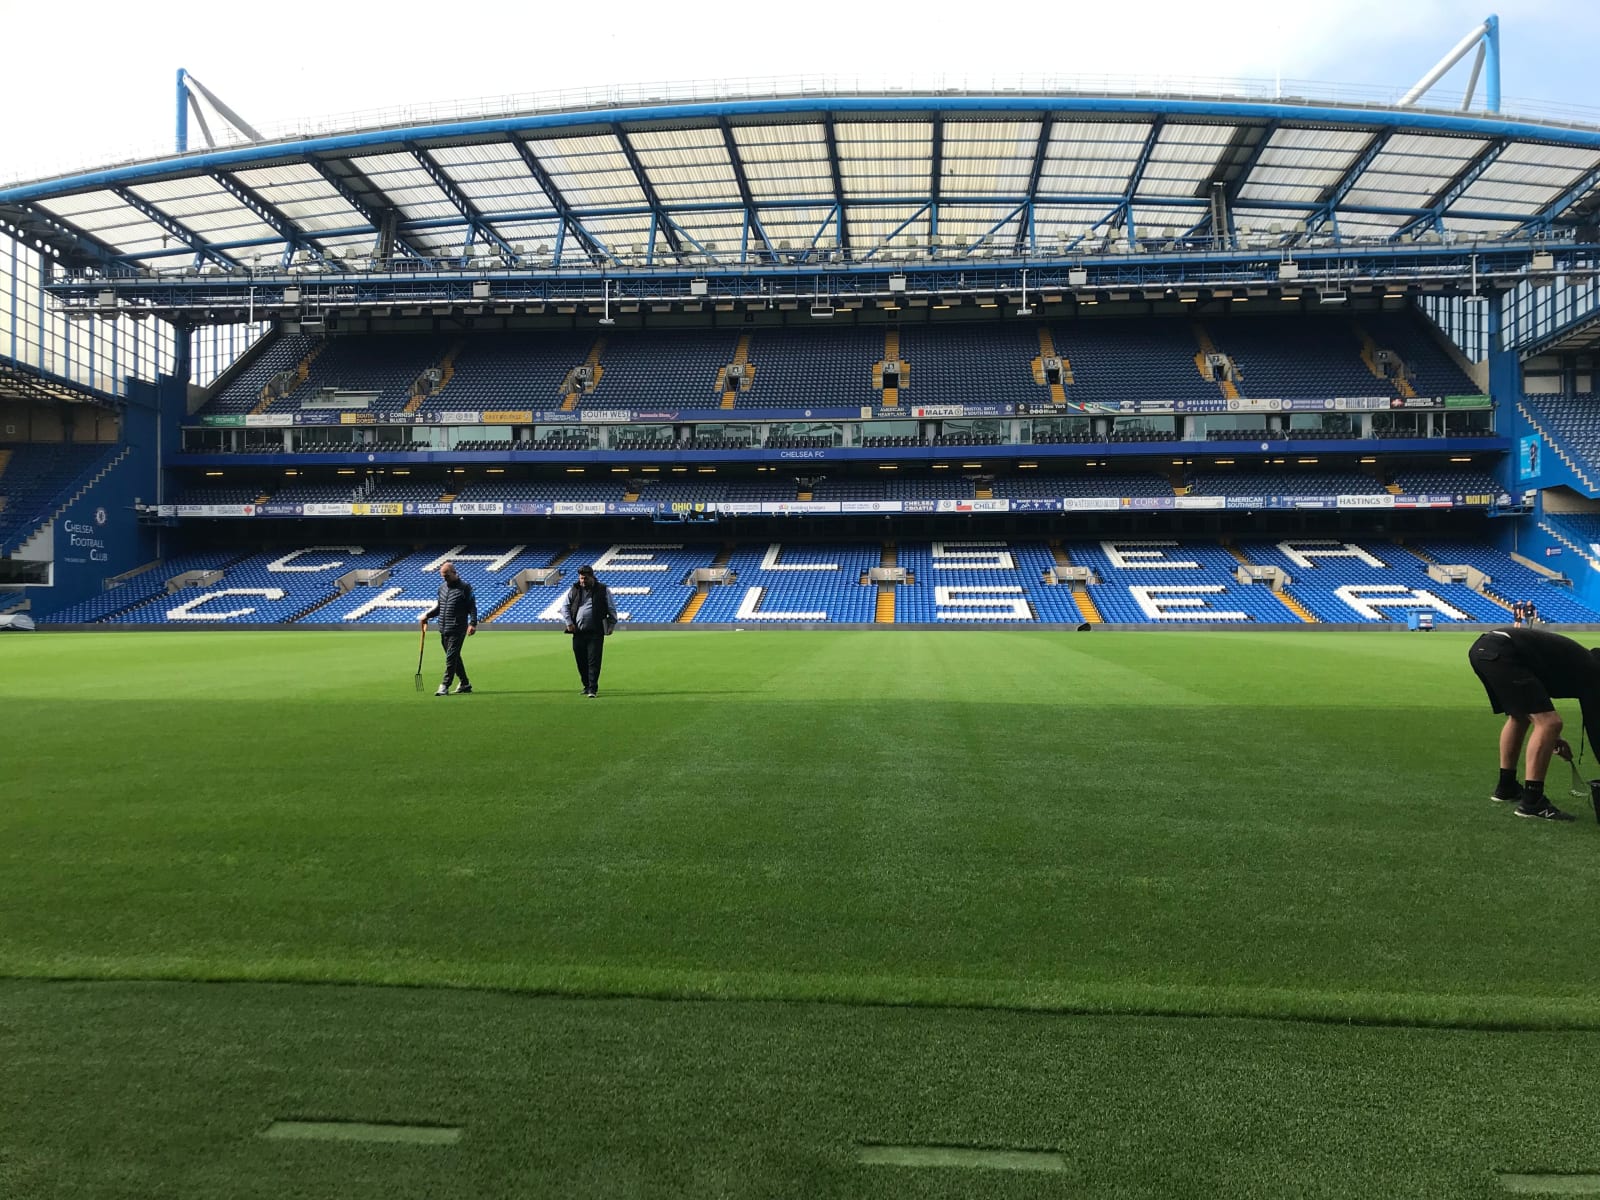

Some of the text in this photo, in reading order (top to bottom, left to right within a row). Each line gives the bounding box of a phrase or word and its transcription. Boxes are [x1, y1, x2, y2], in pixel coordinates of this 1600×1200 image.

[610, 410, 630, 418] WEST
[672, 502, 692, 512] OHIO
[64, 520, 94, 534] CHELSEA
[70, 534, 104, 548] FOOTBALL
[90, 549, 108, 561] CLUB
